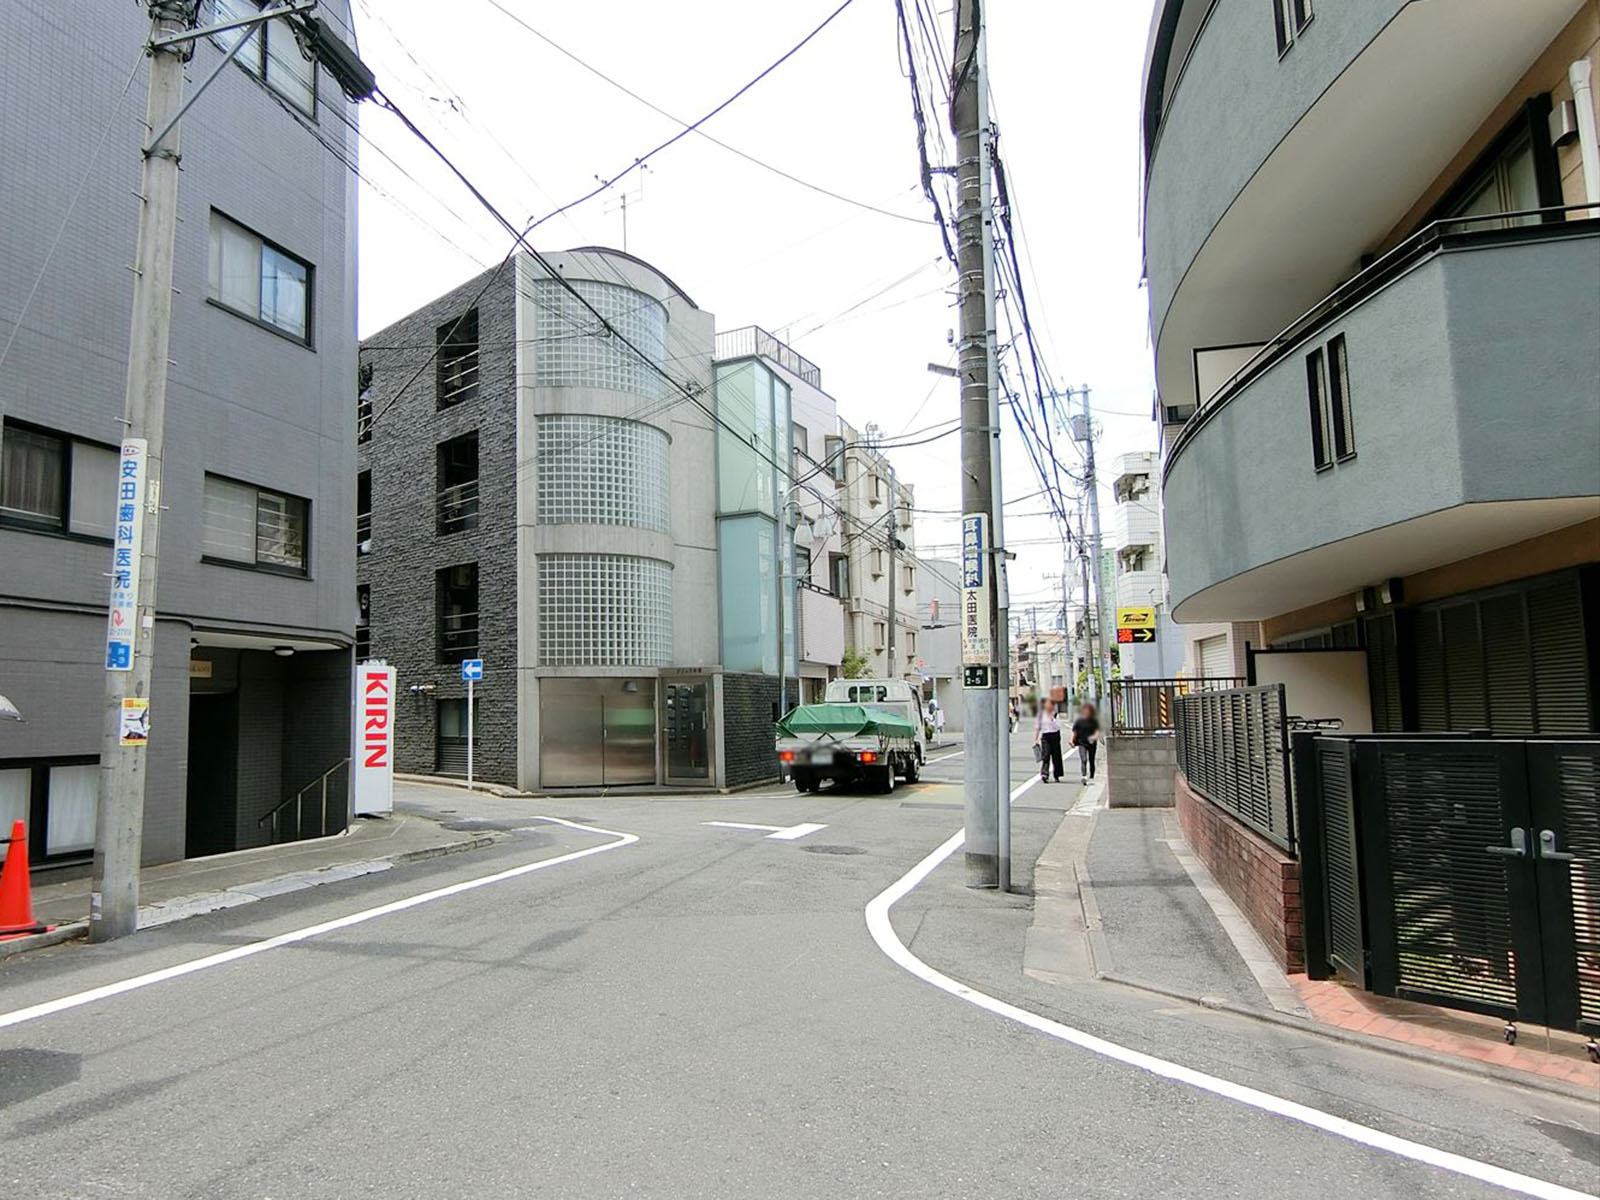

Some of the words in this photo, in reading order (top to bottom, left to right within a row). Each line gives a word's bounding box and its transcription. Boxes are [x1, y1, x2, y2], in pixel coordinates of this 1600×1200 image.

[114, 460, 137, 588] 安田歯科医院
[966, 590, 978, 638] 太田医院
[365, 673, 388, 768] KIRIN
